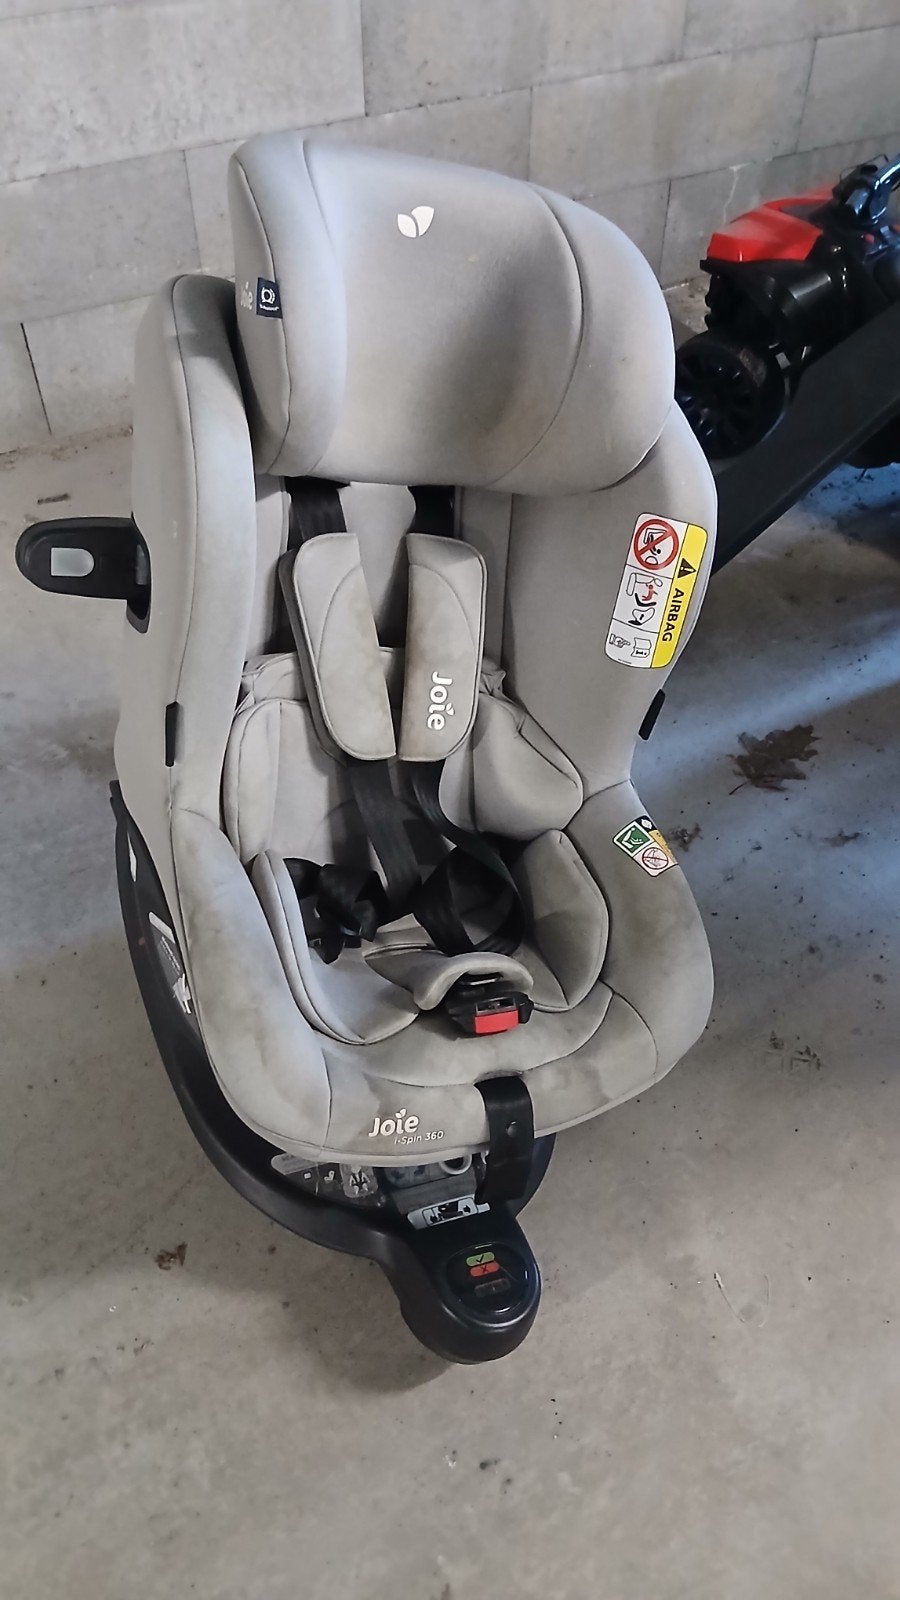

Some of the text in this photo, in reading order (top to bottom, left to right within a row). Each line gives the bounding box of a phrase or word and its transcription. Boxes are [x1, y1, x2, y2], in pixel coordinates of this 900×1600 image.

[662, 587, 684, 642] AIRBAG
[427, 671, 454, 730] Joie
[368, 1108, 419, 1137] Joie
[424, 1130, 444, 1141] 360
